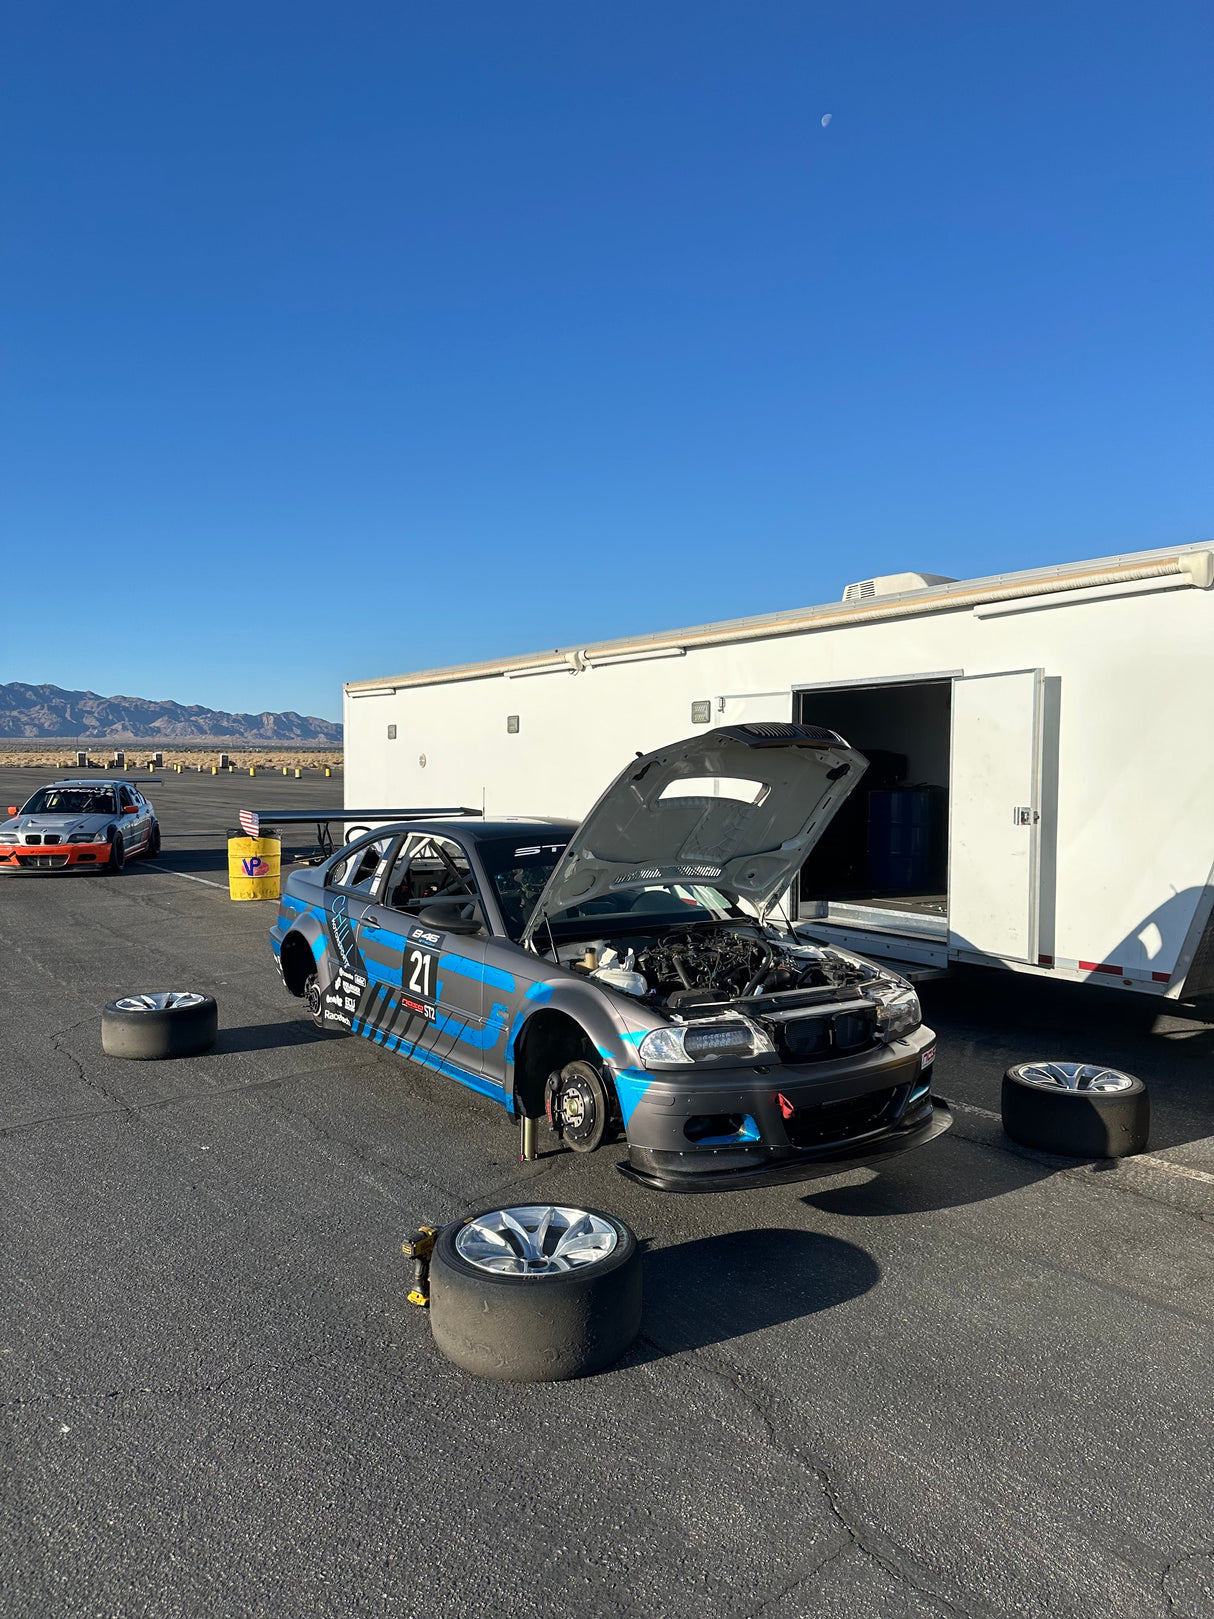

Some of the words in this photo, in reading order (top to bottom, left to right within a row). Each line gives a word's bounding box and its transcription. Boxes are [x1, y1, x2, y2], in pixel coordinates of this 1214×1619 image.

[242, 857, 262, 876] VP
[409, 950, 432, 996] 21
[424, 1004, 436, 1020] ST2
